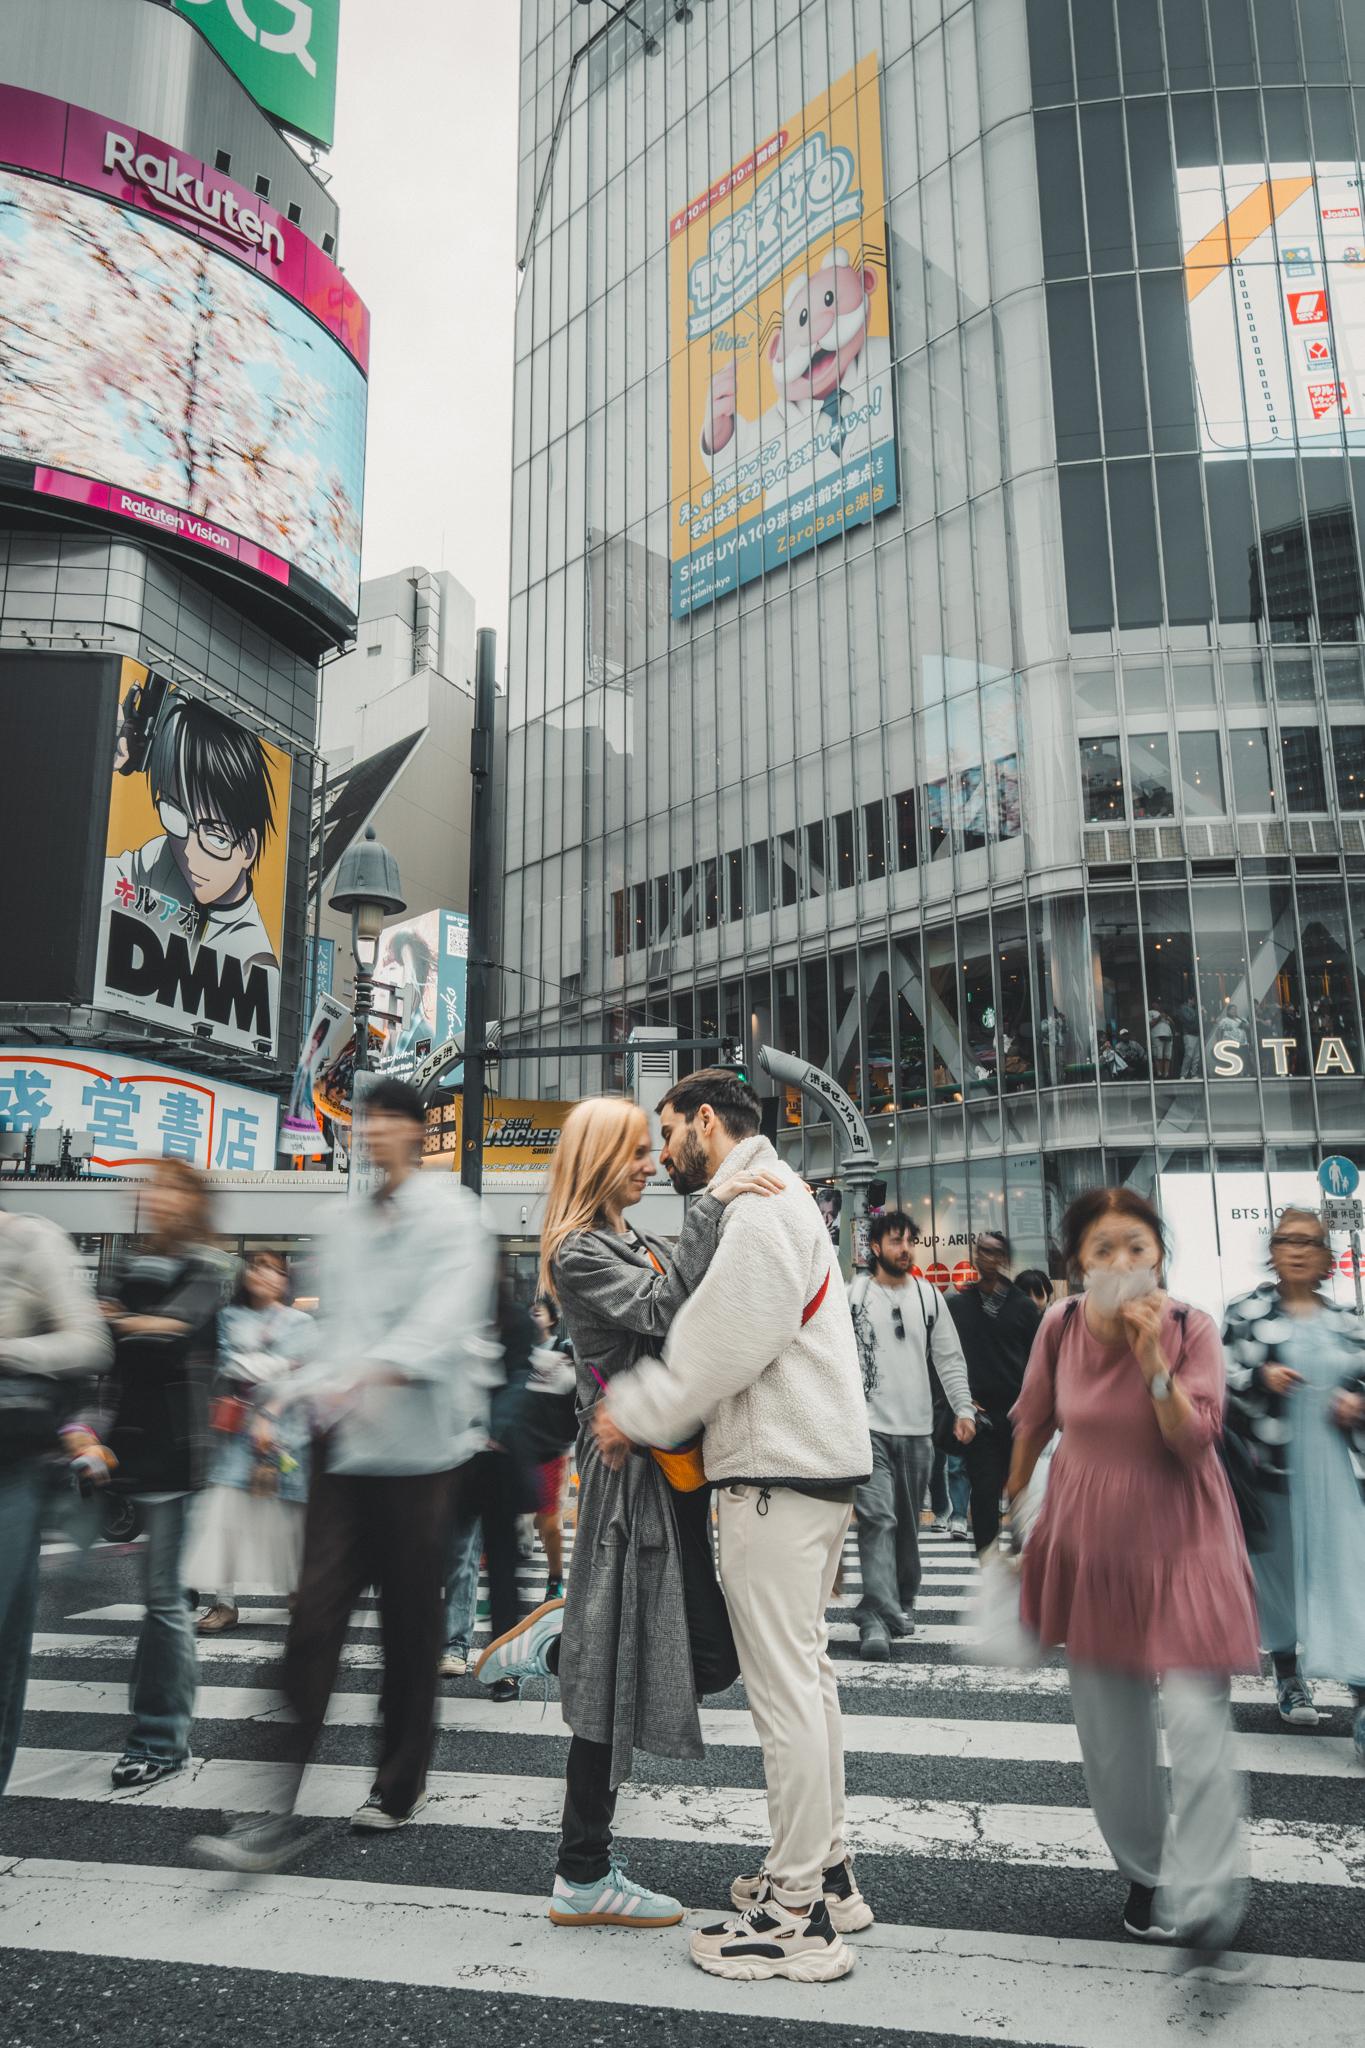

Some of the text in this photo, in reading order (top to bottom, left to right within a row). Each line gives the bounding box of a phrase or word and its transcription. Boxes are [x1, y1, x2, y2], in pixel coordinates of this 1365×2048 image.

[104, 131, 285, 262] Rakuten
[755, 136, 822, 218] SIMI
[693, 151, 851, 301] TOKYO
[1325, 208, 1357, 218] Joshin
[120, 495, 231, 550] Rakuten Vision
[776, 483, 885, 554] ZeroBase渋谷
[114, 877, 200, 934] キルアオ
[105, 909, 272, 1039] DMM
[1212, 1037, 1356, 1077] STA
[506, 1117, 532, 1128] SUN
[810, 1072, 865, 1148] 渋谷センター街
[1231, 1208, 1260, 1220] BTS
[1325, 1200, 1334, 1209] 15
[1352, 1200, 1359, 1209] 5
[1354, 1220, 1360, 1229] 5
